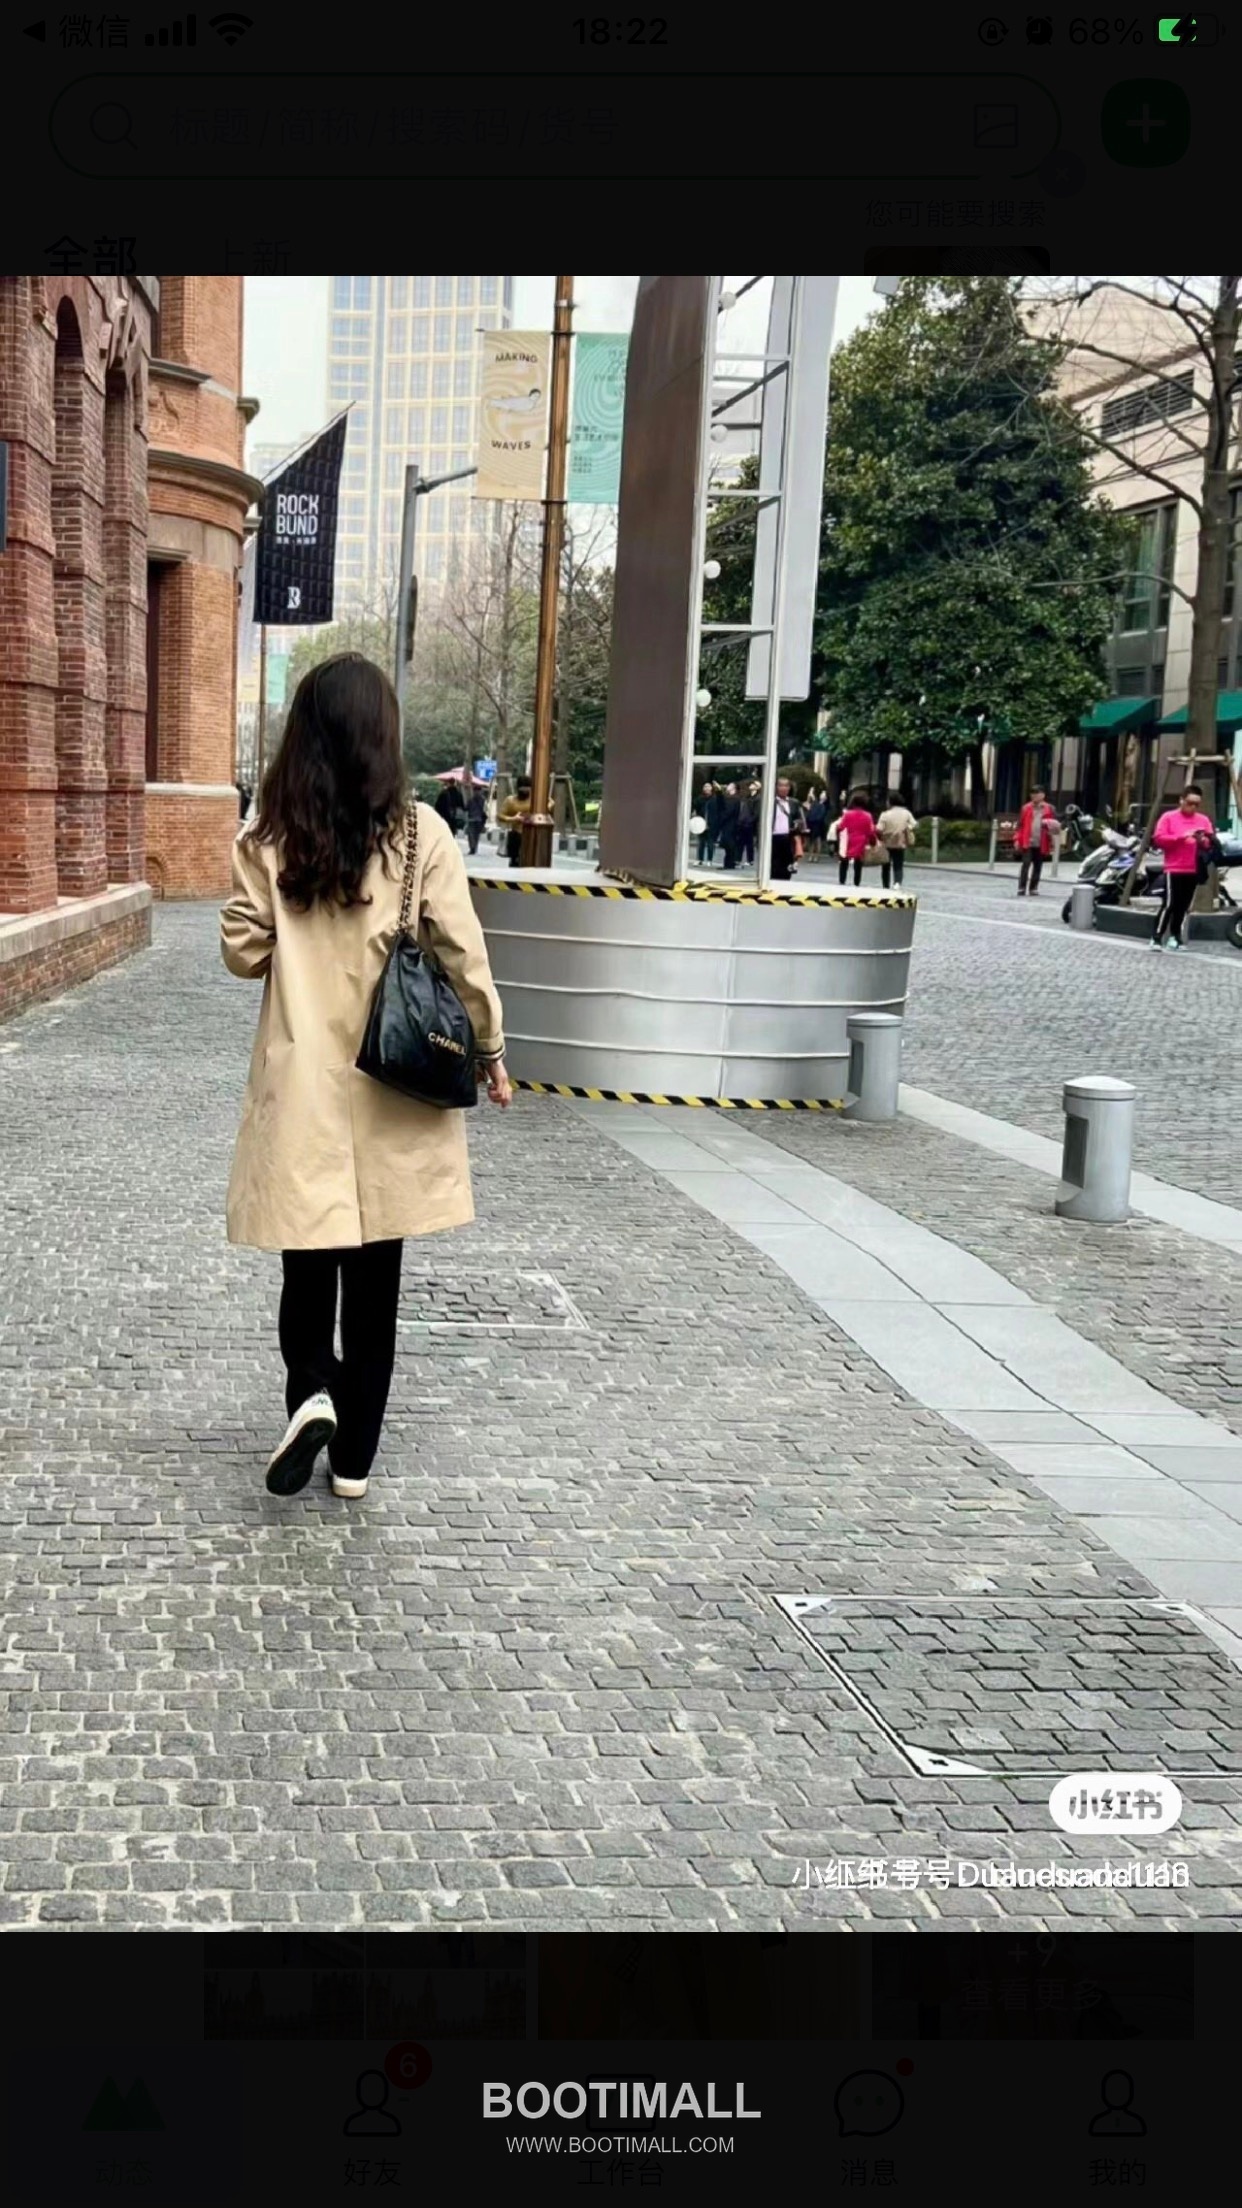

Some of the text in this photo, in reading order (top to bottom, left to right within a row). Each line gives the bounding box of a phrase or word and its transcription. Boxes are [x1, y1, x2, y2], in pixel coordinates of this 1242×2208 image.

[58, 14, 131, 49] 微信
[572, 17, 668, 46] 18:22
[1068, 17, 1144, 46] 68%
[864, 198, 1047, 228] 您可能要搜索
[43, 235, 137, 276] 全部
[495, 352, 538, 363] MAKING
[491, 439, 532, 451] WAVES
[276, 494, 319, 516] ROCK
[275, 515, 319, 536] BUND
[428, 1032, 467, 1056] CHANEL
[400, 2054, 418, 2078] 6
[343, 2157, 401, 2187] 好友
[576, 2157, 665, 2187] 工作台
[840, 2157, 899, 2187] 消息
[1088, 2157, 1147, 2187] 我的
